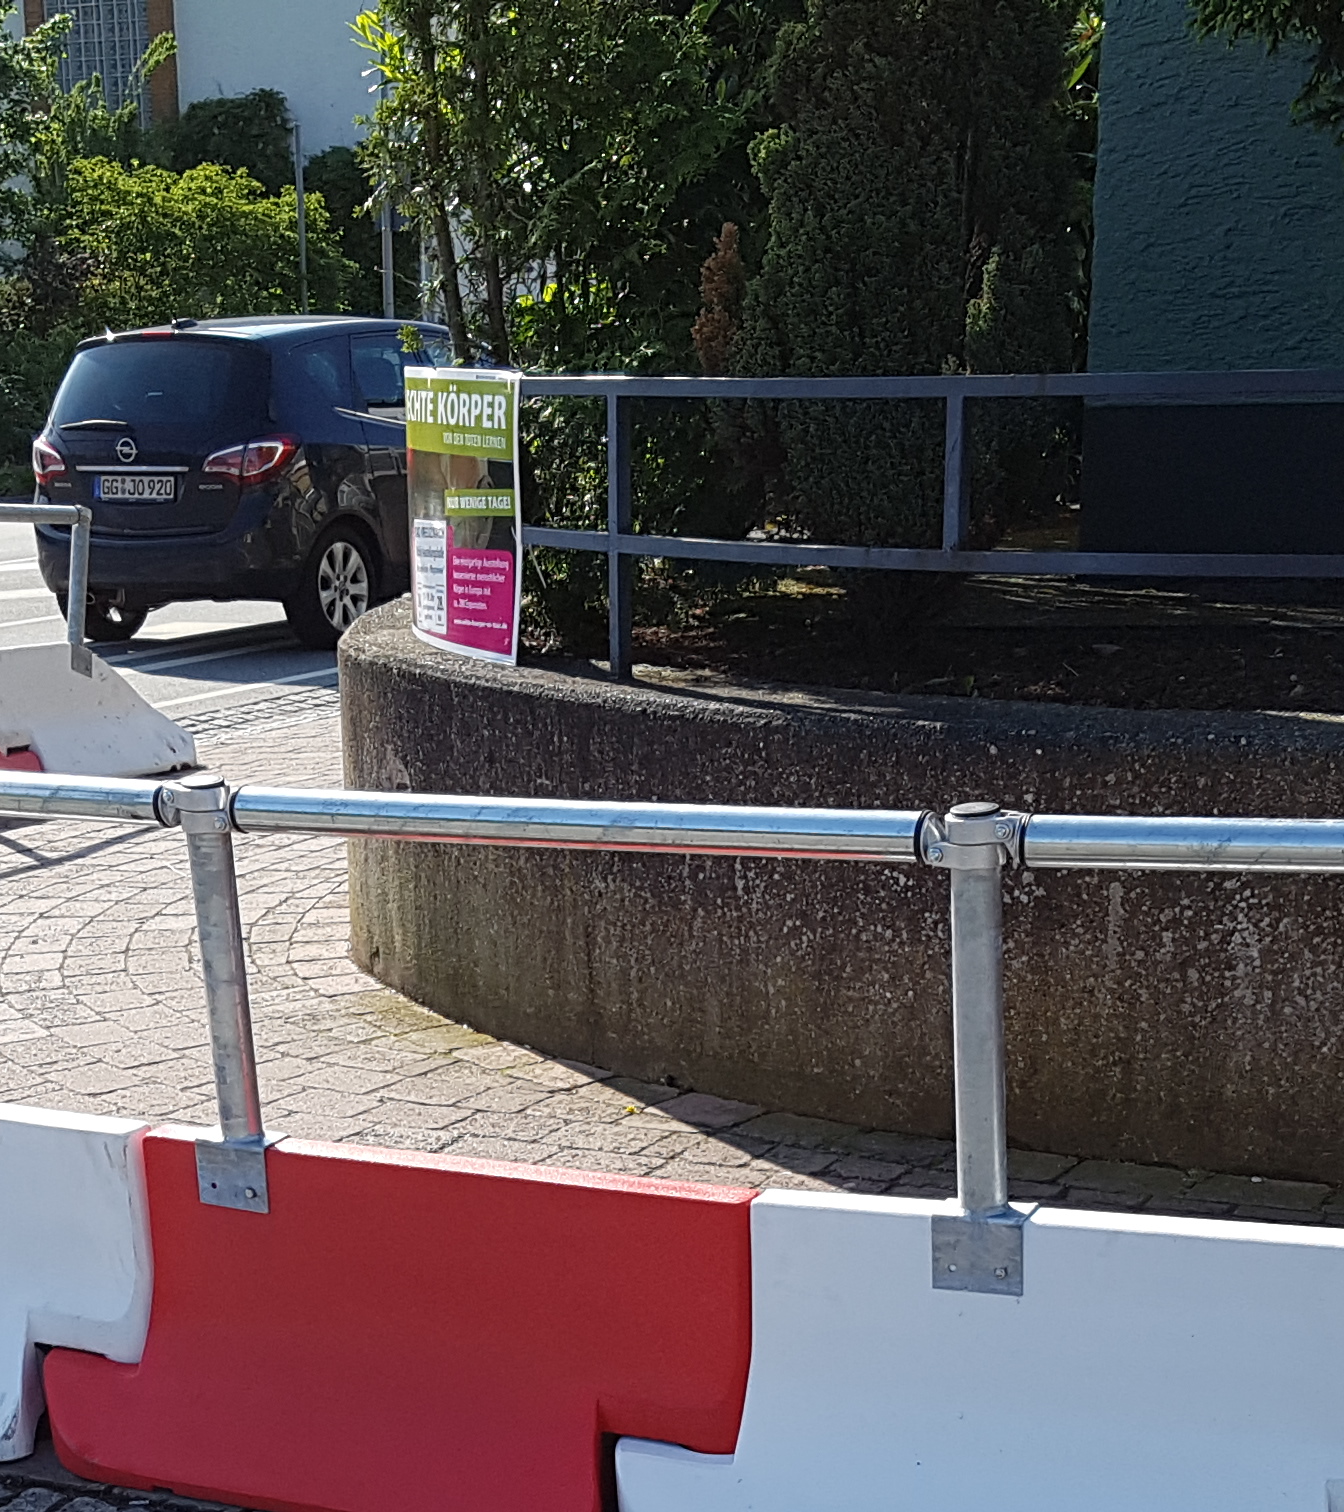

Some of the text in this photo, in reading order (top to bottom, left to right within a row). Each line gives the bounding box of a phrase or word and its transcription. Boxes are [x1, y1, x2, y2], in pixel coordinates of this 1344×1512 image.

[438, 384, 507, 429] KÖRPER
[482, 434, 506, 449] LERNEN
[102, 478, 172, 496] GG JO 920
[459, 496, 487, 509] WENIGE
